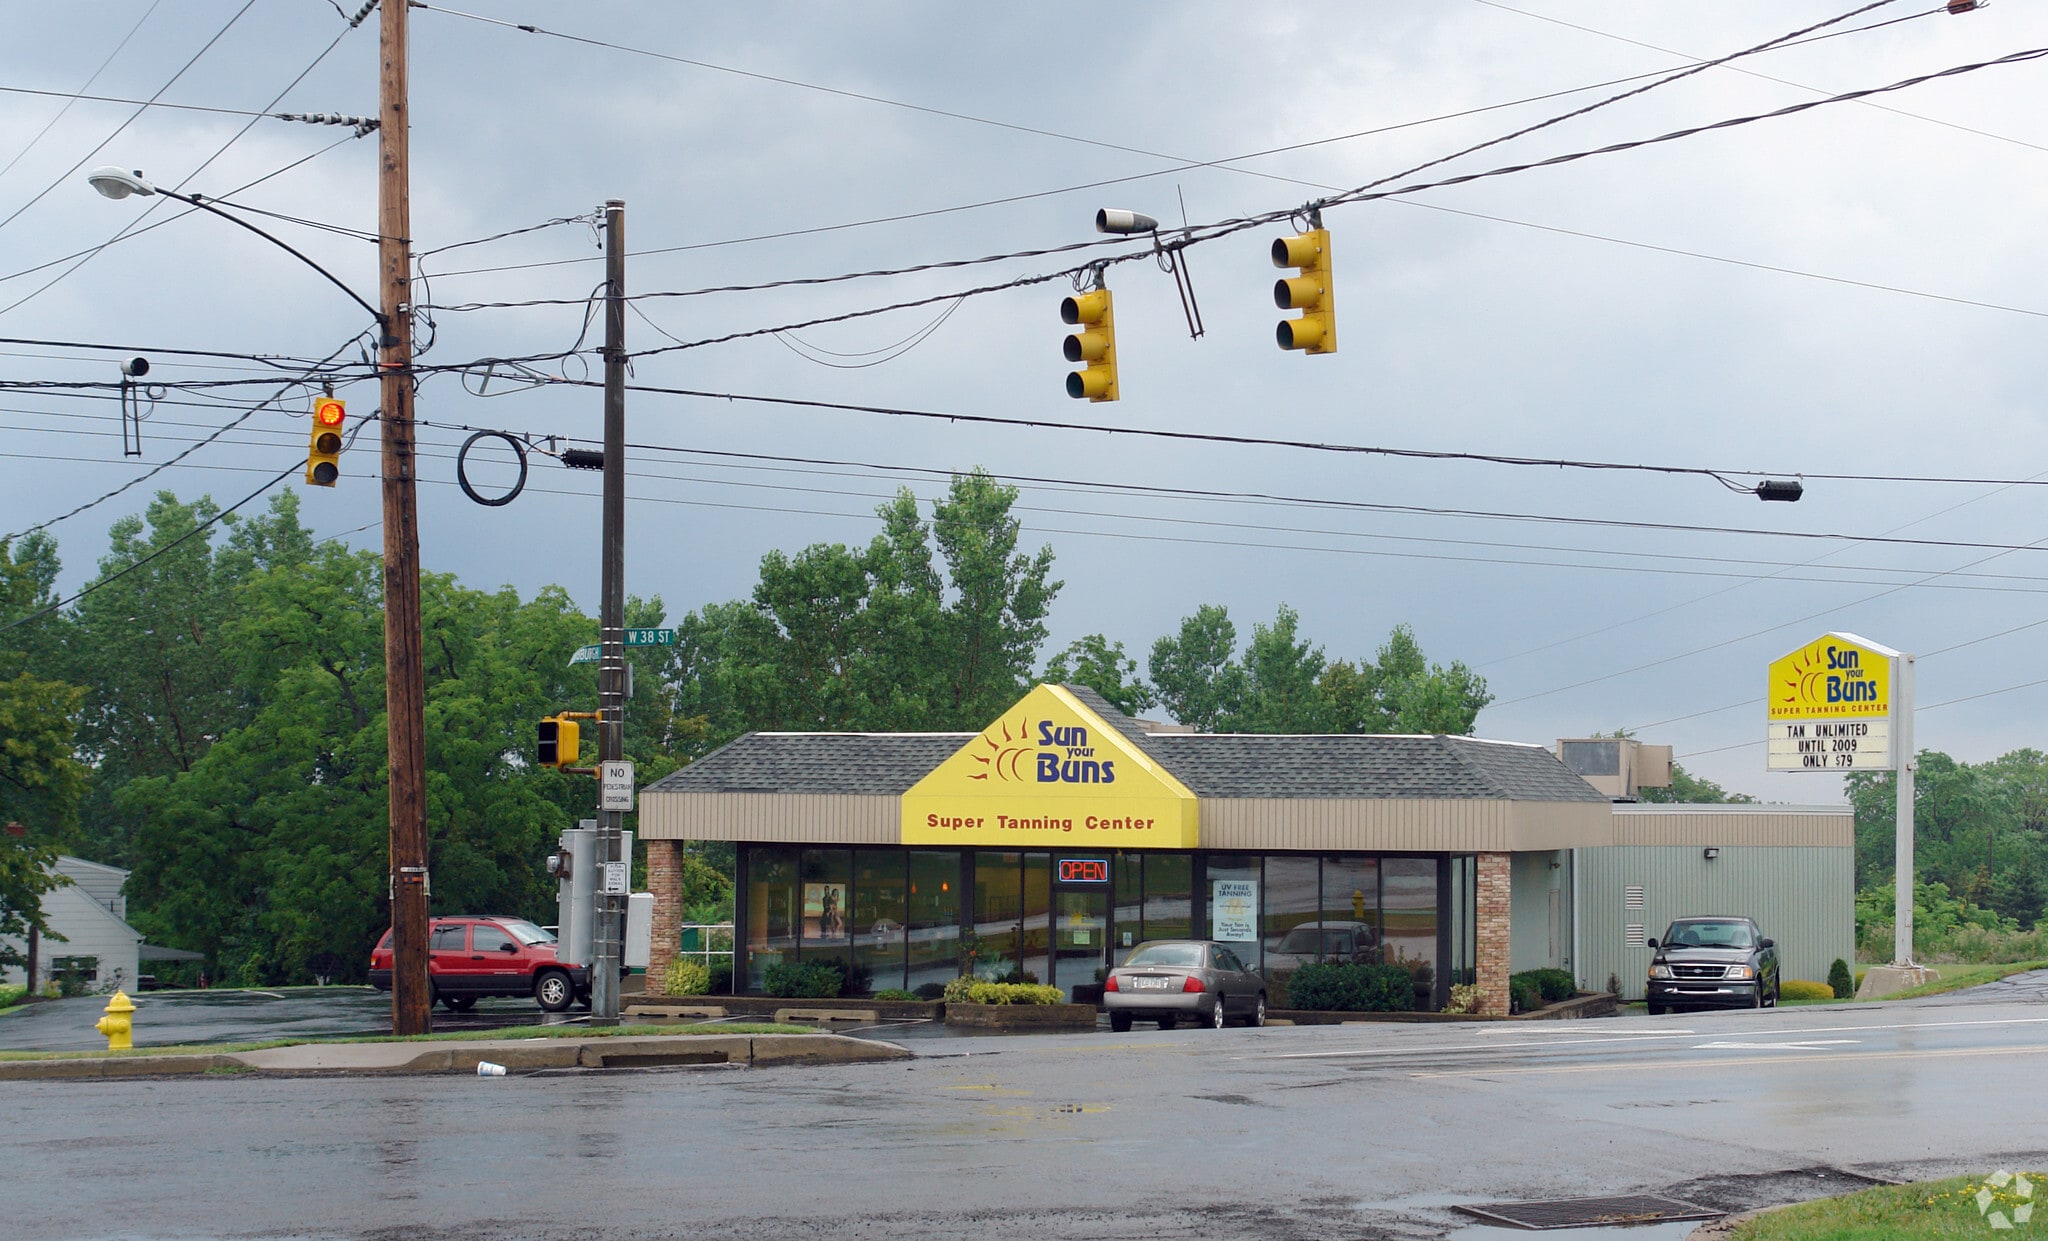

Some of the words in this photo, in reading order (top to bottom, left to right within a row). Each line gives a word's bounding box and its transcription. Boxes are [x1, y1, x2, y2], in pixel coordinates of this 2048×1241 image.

[629, 631, 637, 643] W
[640, 631, 654, 643] 38
[658, 631, 670, 643] ST
[1827, 646, 1858, 669] Sun
[1846, 669, 1864, 680] your
[1827, 675, 1877, 703] Buns
[1771, 707, 1800, 715] SUPER
[1805, 705, 1846, 714] TANNING
[1851, 703, 1888, 712] CENTER
[1038, 720, 1087, 746] Sun
[1787, 725, 1805, 738] TAN
[1815, 724, 1868, 737] UNLIMITED
[1798, 740, 1826, 752] UNTIL
[1832, 739, 1857, 751] 2009
[1066, 747, 1094, 759] your
[1803, 755, 1828, 767] ONLY
[1835, 755, 1853, 767] $79
[610, 768, 625, 778] NO
[1037, 753, 1115, 783] Buns
[927, 813, 984, 831] Super
[997, 815, 1073, 832] Tanning
[1085, 816, 1154, 830] Center
[1060, 861, 1107, 880] OPEN
